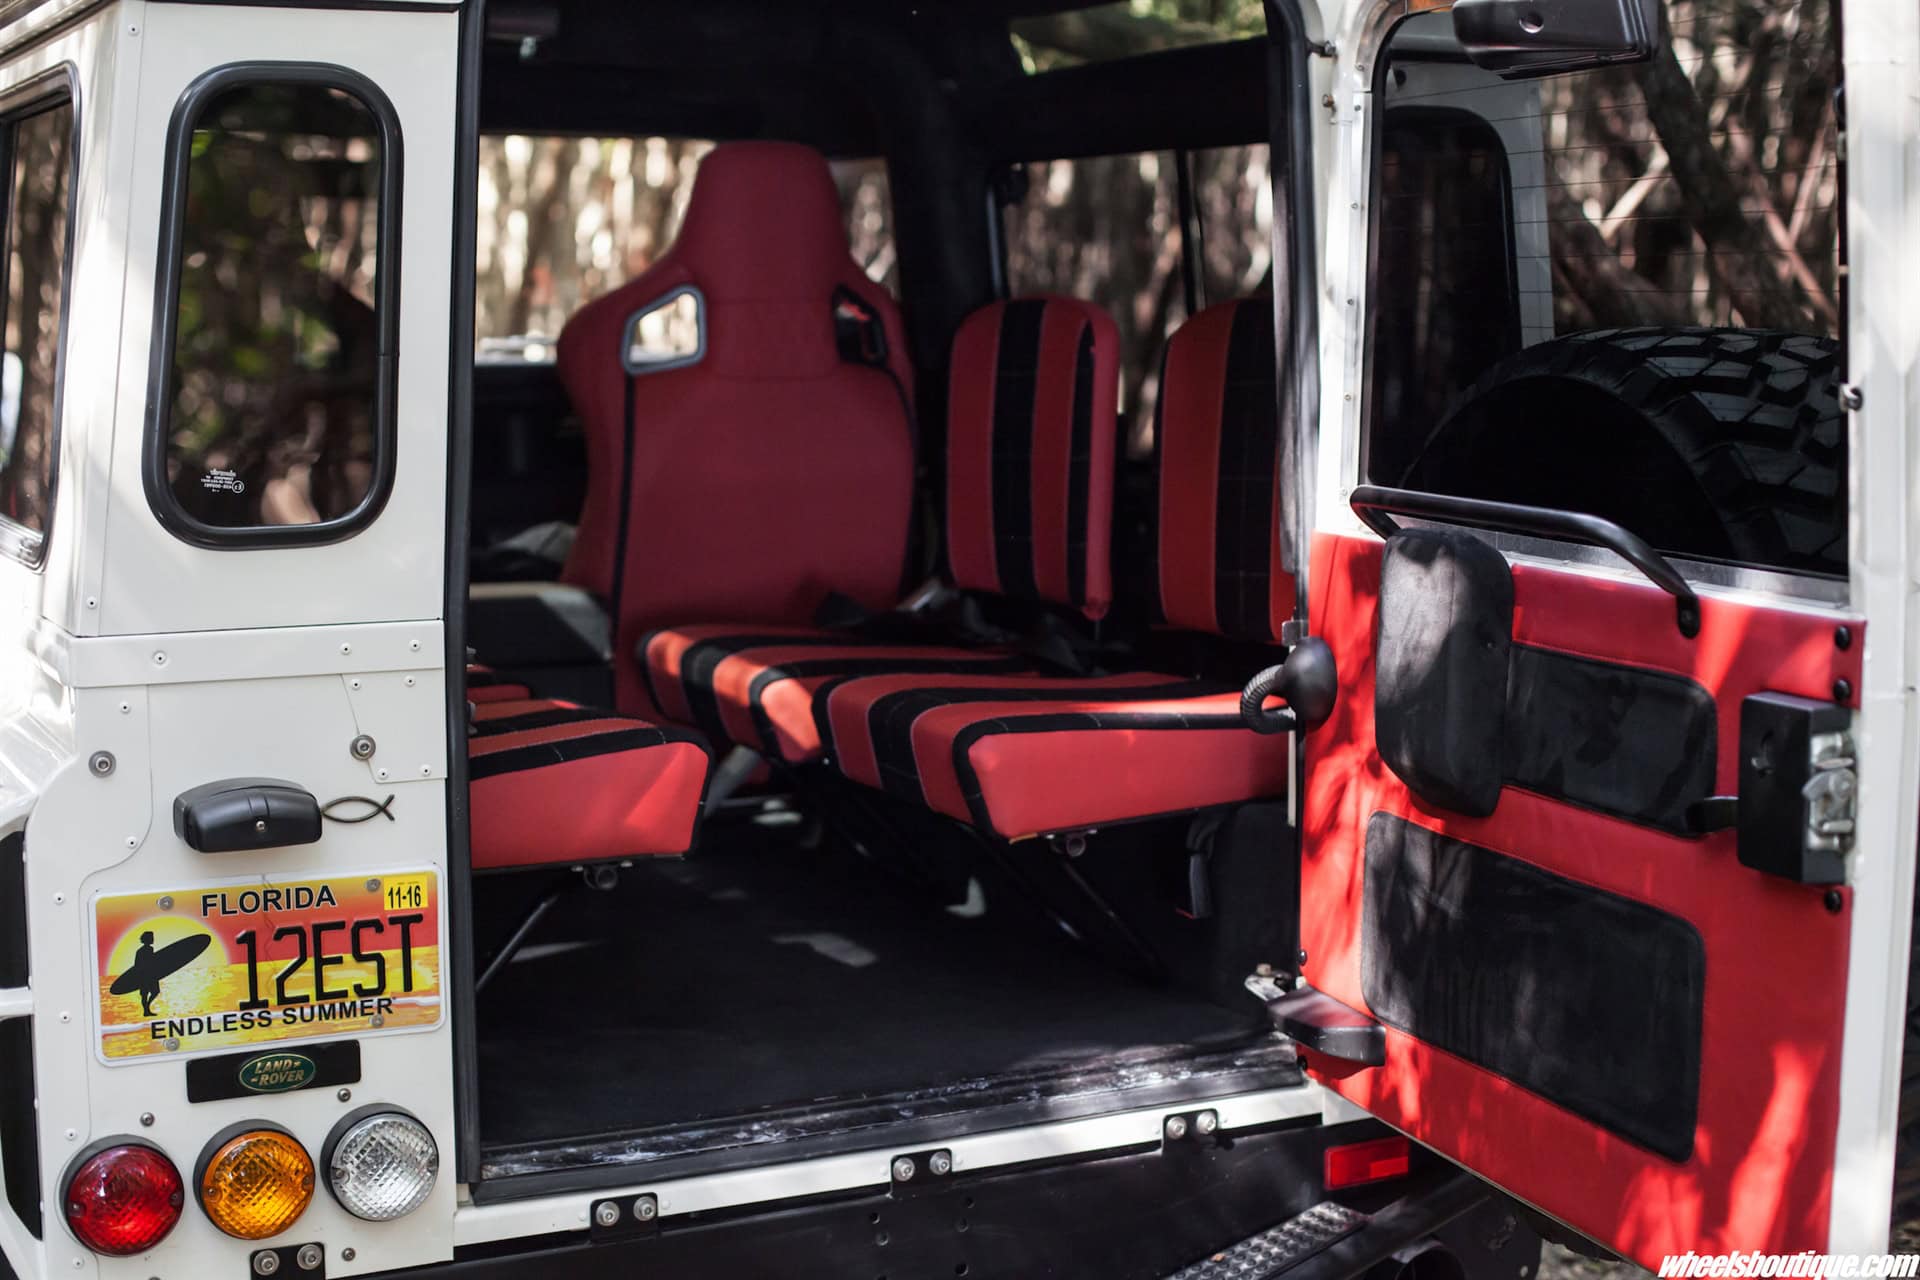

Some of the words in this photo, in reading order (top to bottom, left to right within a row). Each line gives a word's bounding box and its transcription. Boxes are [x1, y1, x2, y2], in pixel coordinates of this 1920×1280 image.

[201, 885, 336, 916] FLORIDA
[387, 885, 422, 909] 11-16
[236, 913, 424, 1010] 12EST
[151, 1013, 273, 1040] ENDLESS
[282, 999, 394, 1025] SUMMER
[254, 1060, 293, 1074] LAND
[259, 1069, 305, 1085] ROVER
